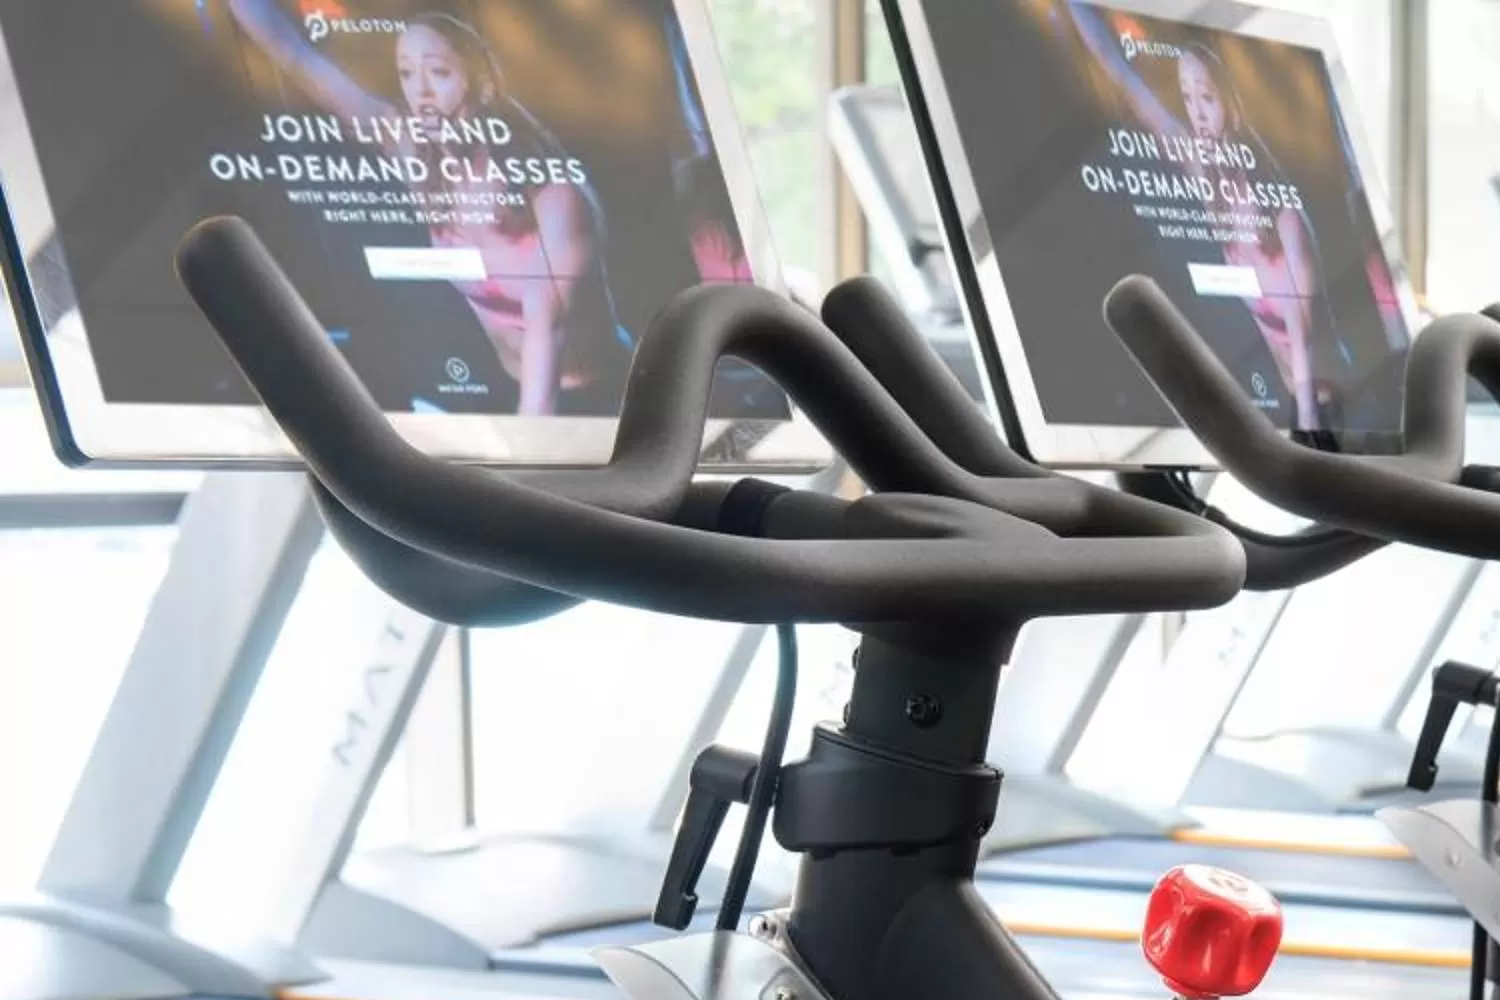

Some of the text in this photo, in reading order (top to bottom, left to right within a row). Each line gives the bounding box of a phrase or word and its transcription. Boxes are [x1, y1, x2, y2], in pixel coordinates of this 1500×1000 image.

[330, 17, 408, 33] PELOTON
[260, 114, 512, 146] JOIN LIVE AND
[1107, 127, 1257, 170] JOIN LIVE AND
[209, 153, 588, 185] ON-DEMAND CLASSES
[287, 190, 325, 204] WITH
[1080, 164, 1304, 211] ON-DEMAND CLASSES
[322, 209, 367, 223] RIGHT
[415, 210, 459, 224] RIGHT
[330, 605, 407, 767] MAT
